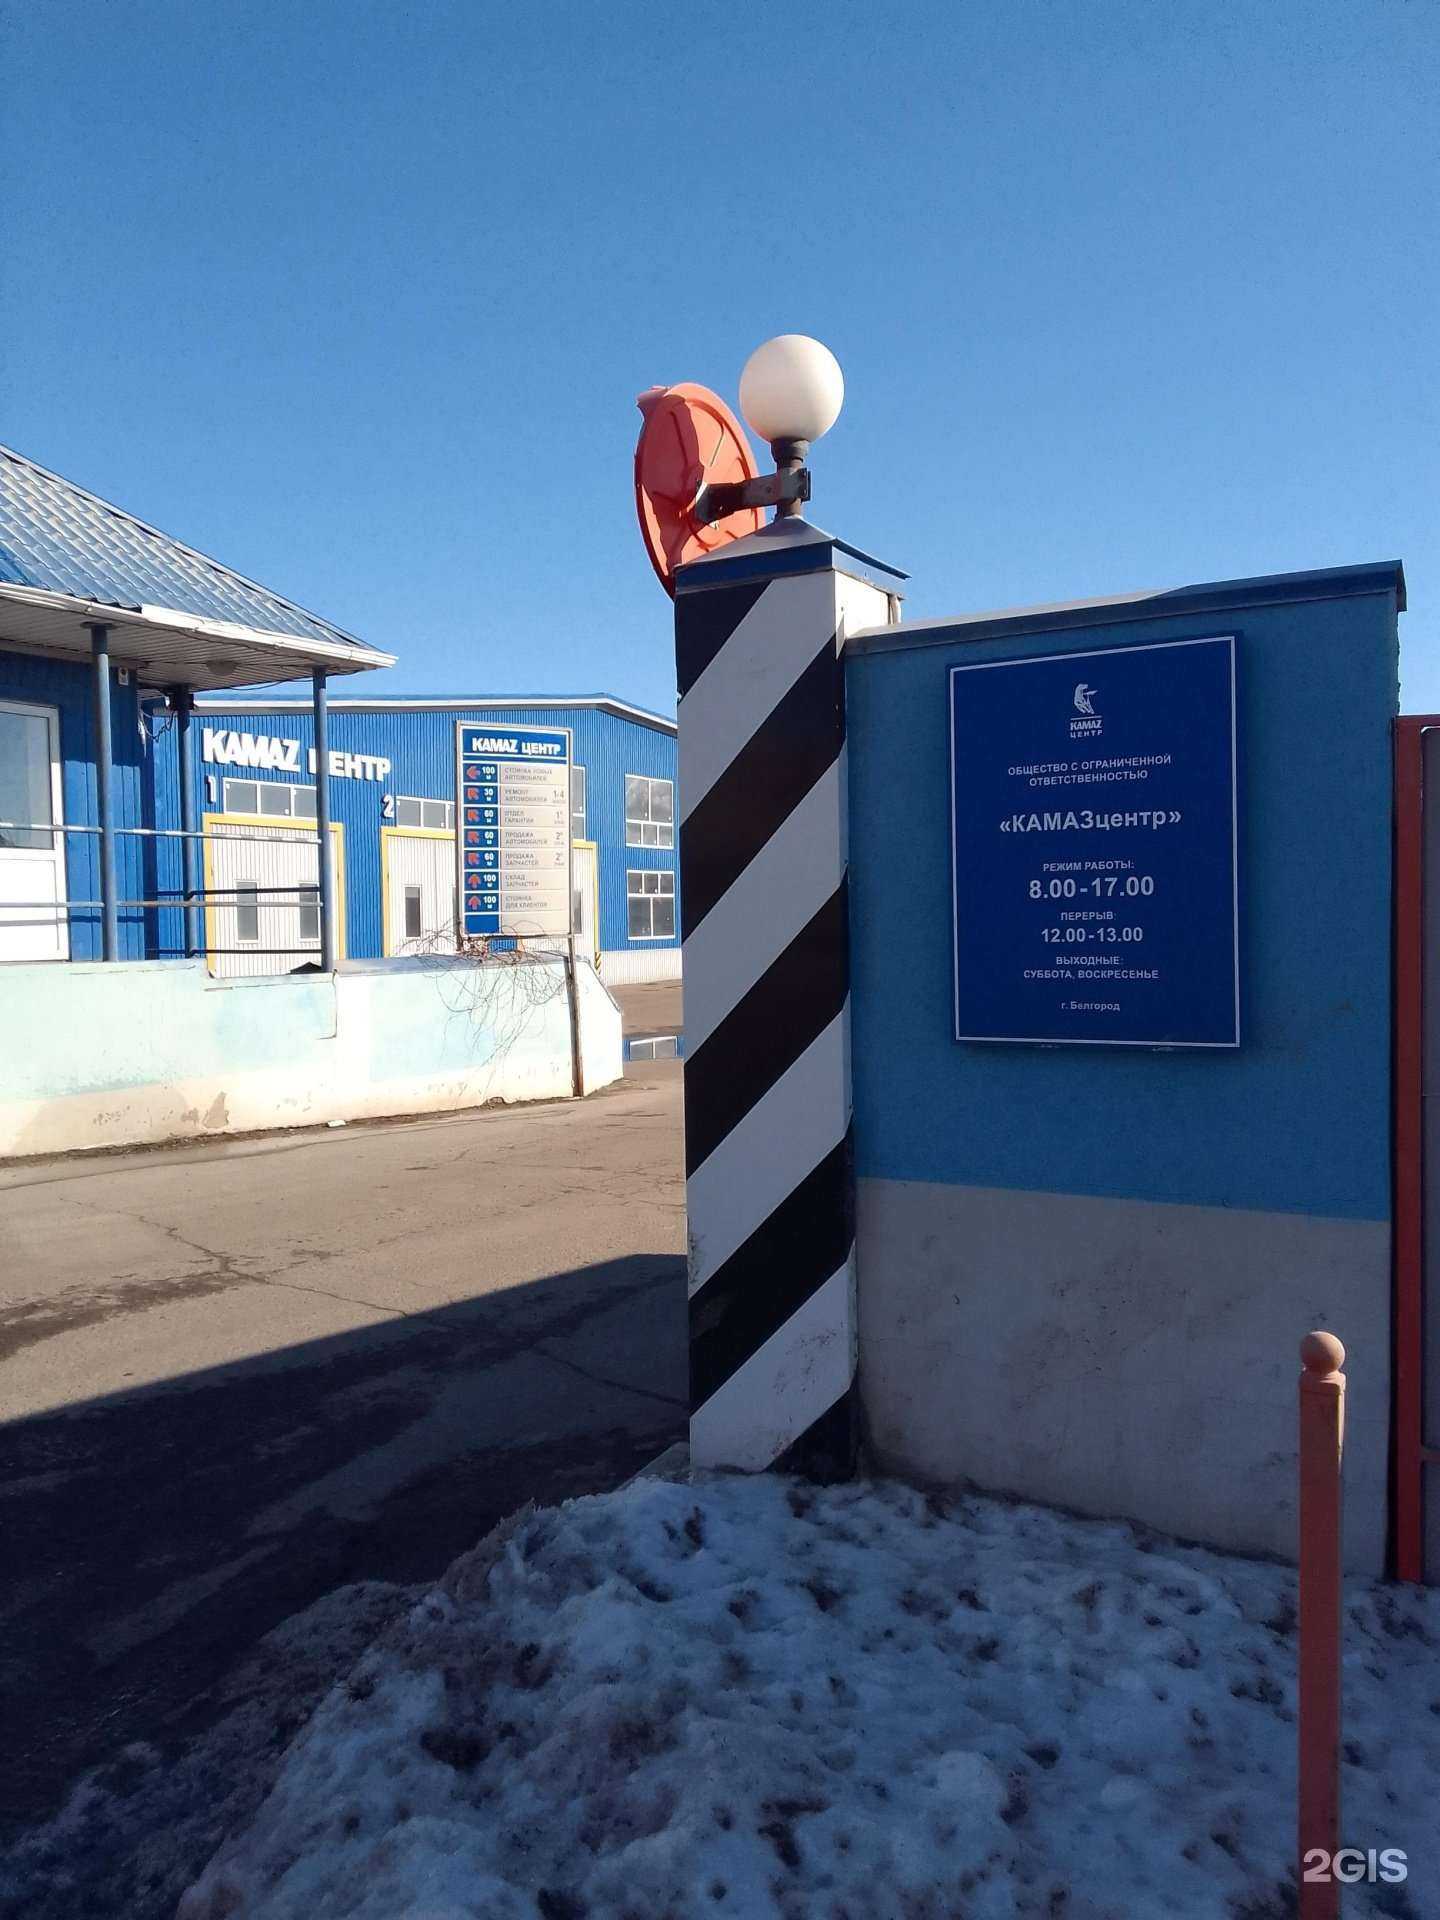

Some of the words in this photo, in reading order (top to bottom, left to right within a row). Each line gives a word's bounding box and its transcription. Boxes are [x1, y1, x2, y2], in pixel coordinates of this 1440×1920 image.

[1070, 720, 1102, 731] KAMAZ
[1070, 730, 1103, 739] ЦЕНТР
[202, 728, 301, 773] KAMAZ
[472, 737, 518, 753] KAMAZ
[521, 742, 561, 756] ЦЕНТР
[482, 766, 496, 775] 100
[1008, 762, 1068, 776] ОБЩЕСТВО
[1071, 762, 1078, 771] С
[1081, 754, 1171, 770] ОГРАНИЧЕННОЙ
[1029, 769, 1148, 787] ОТВЕТСТВЕННОСТЬЮ
[206, 774, 217, 804] 1
[484, 788, 494, 796] 30
[382, 794, 395, 819] 2
[484, 810, 494, 818] 60
[999, 810, 1182, 833] «КАМАЗцентр»
[484, 831, 494, 839] 60
[484, 852, 494, 861] 60
[1043, 862, 1082, 872] РЕЖИМ
[1084, 860, 1135, 871] РАБОТЫ:
[483, 874, 497, 882] 100
[483, 895, 497, 904] 100
[1023, 970, 1075, 980] СУББОТА,
[1077, 970, 1159, 979] ВОСКРЕСЕНЬЕ
[1061, 1002, 1069, 1010] г.
[1070, 1001, 1121, 1012] Белгород
